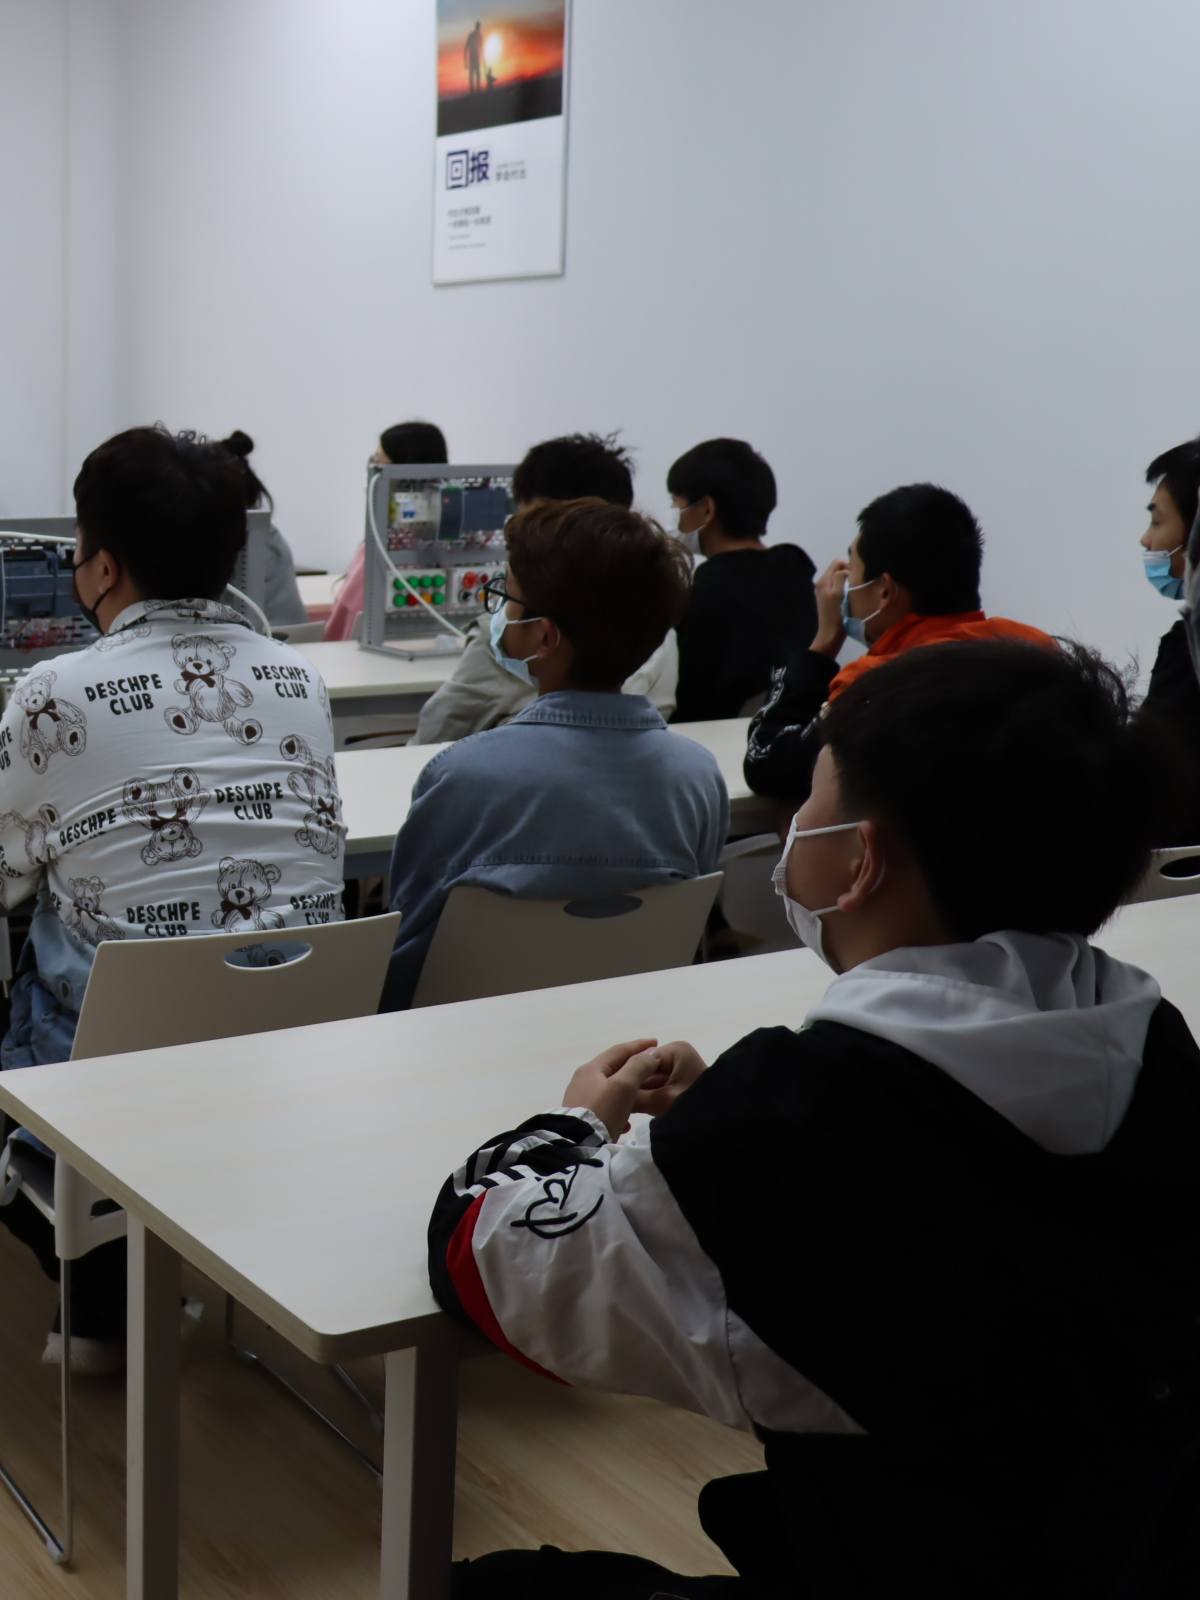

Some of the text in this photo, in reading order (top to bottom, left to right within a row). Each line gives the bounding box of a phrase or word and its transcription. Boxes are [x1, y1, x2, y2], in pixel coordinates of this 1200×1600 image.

[446, 150, 490, 190] 回报
[251, 665, 310, 683] DESCHPE
[84, 673, 163, 702] DESCHPE
[275, 682, 308, 699] CLUB
[109, 693, 154, 715] CLUB
[214, 782, 283, 804] DESCHPE
[234, 802, 273, 820] CLUB
[59, 808, 117, 847] DESCHPE
[126, 902, 200, 923] DESCHPE
[144, 924, 188, 937] CLUB
